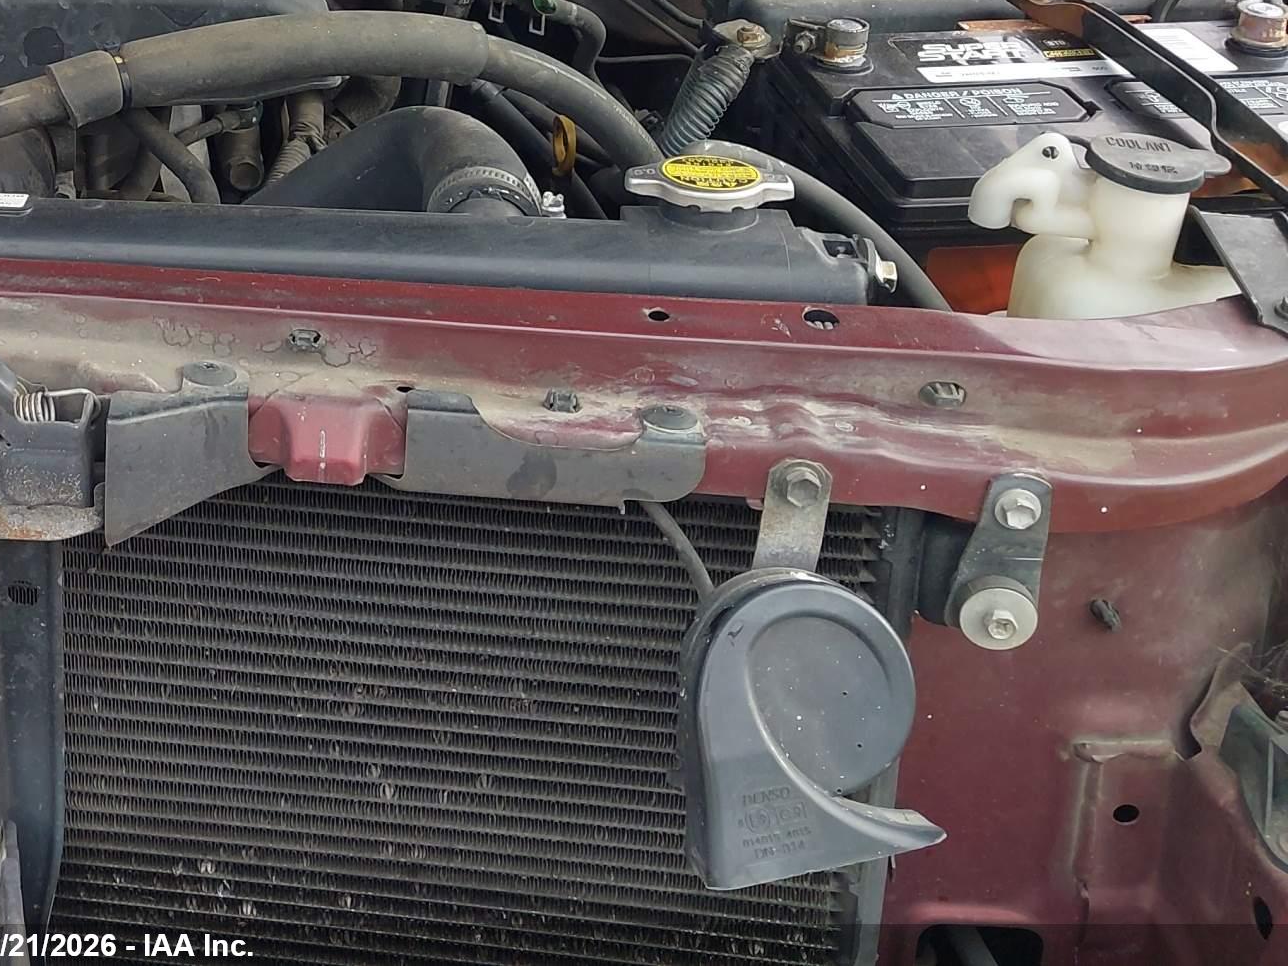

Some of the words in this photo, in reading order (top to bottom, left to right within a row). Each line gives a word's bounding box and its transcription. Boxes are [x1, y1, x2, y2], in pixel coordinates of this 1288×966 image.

[921, 41, 1023, 52] SUPER
[902, 89, 961, 100] DANGER
[971, 87, 1024, 97] POISON
[1105, 136, 1173, 153] COOLANT
